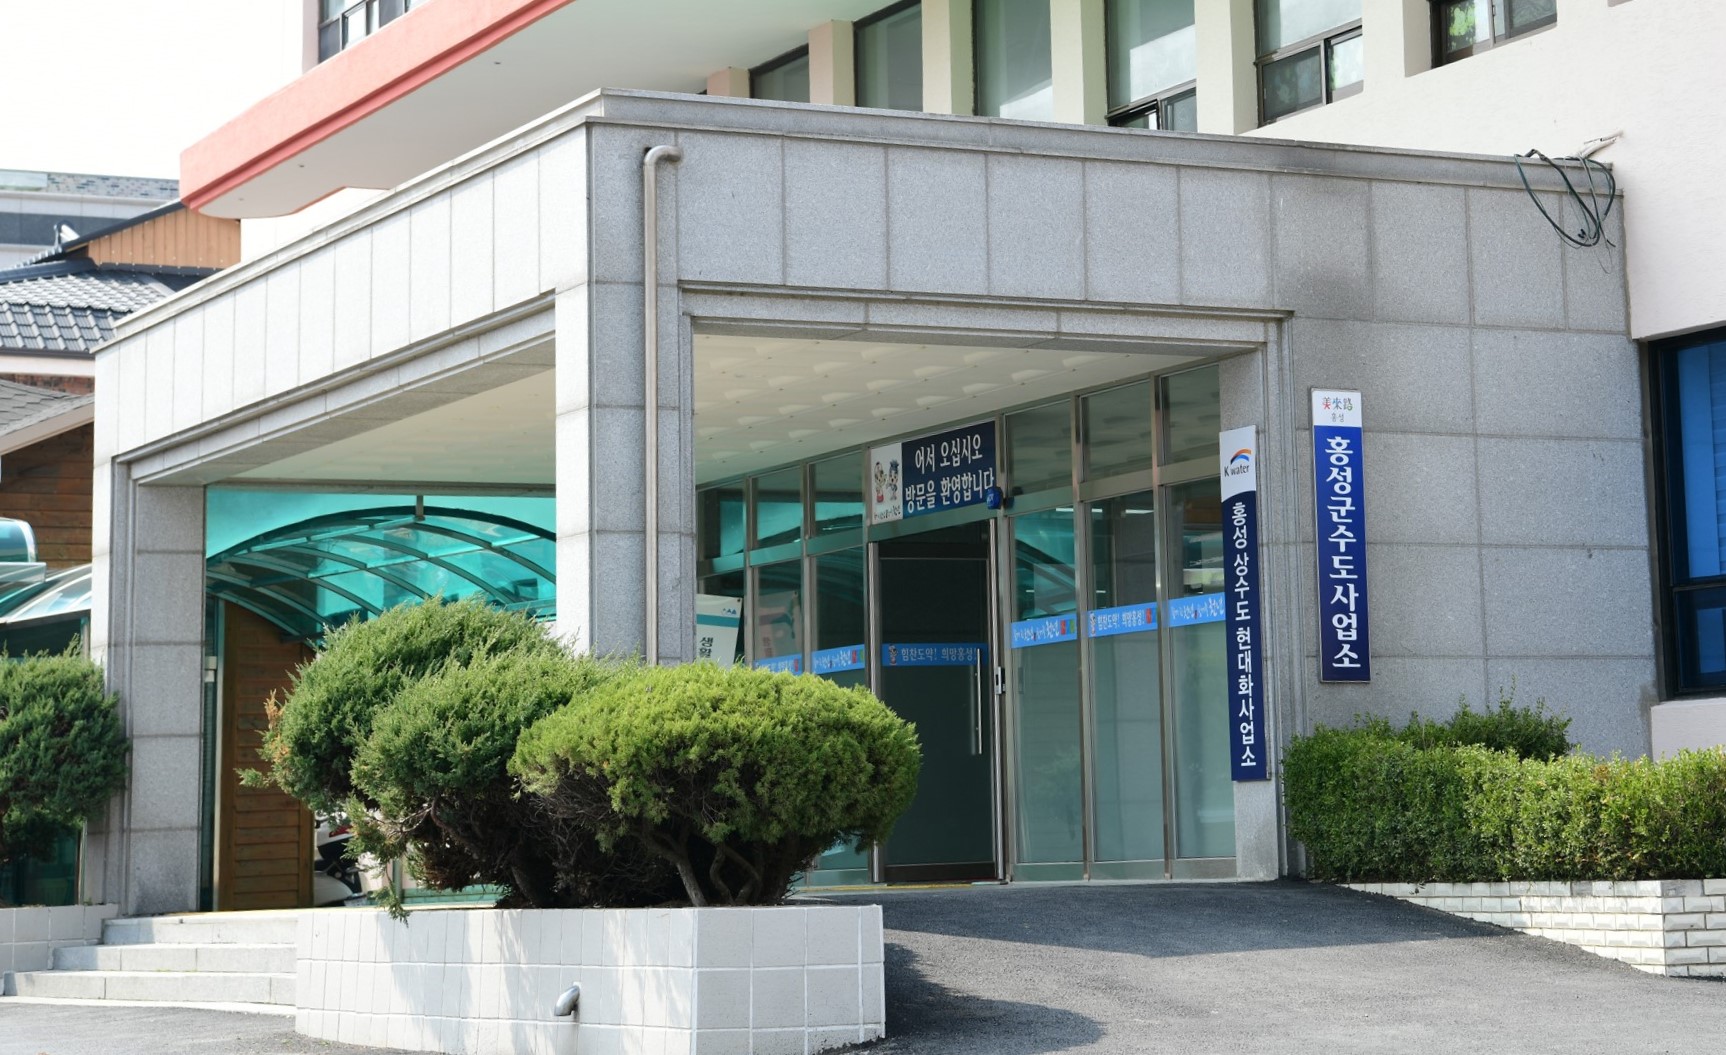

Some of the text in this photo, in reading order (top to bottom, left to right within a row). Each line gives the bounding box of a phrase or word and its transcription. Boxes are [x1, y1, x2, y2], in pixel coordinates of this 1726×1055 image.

[914, 433, 983, 475] 어서 오십시오
[905, 479, 937, 514] 방문을
[940, 467, 995, 506] 환영합니다
[1324, 435, 1361, 669] 홍성군수도사업소
[901, 647, 977, 662] 힘찬도약! 희망홍성!
[1231, 500, 1257, 768] 홍성 상수도 현대화사업소
